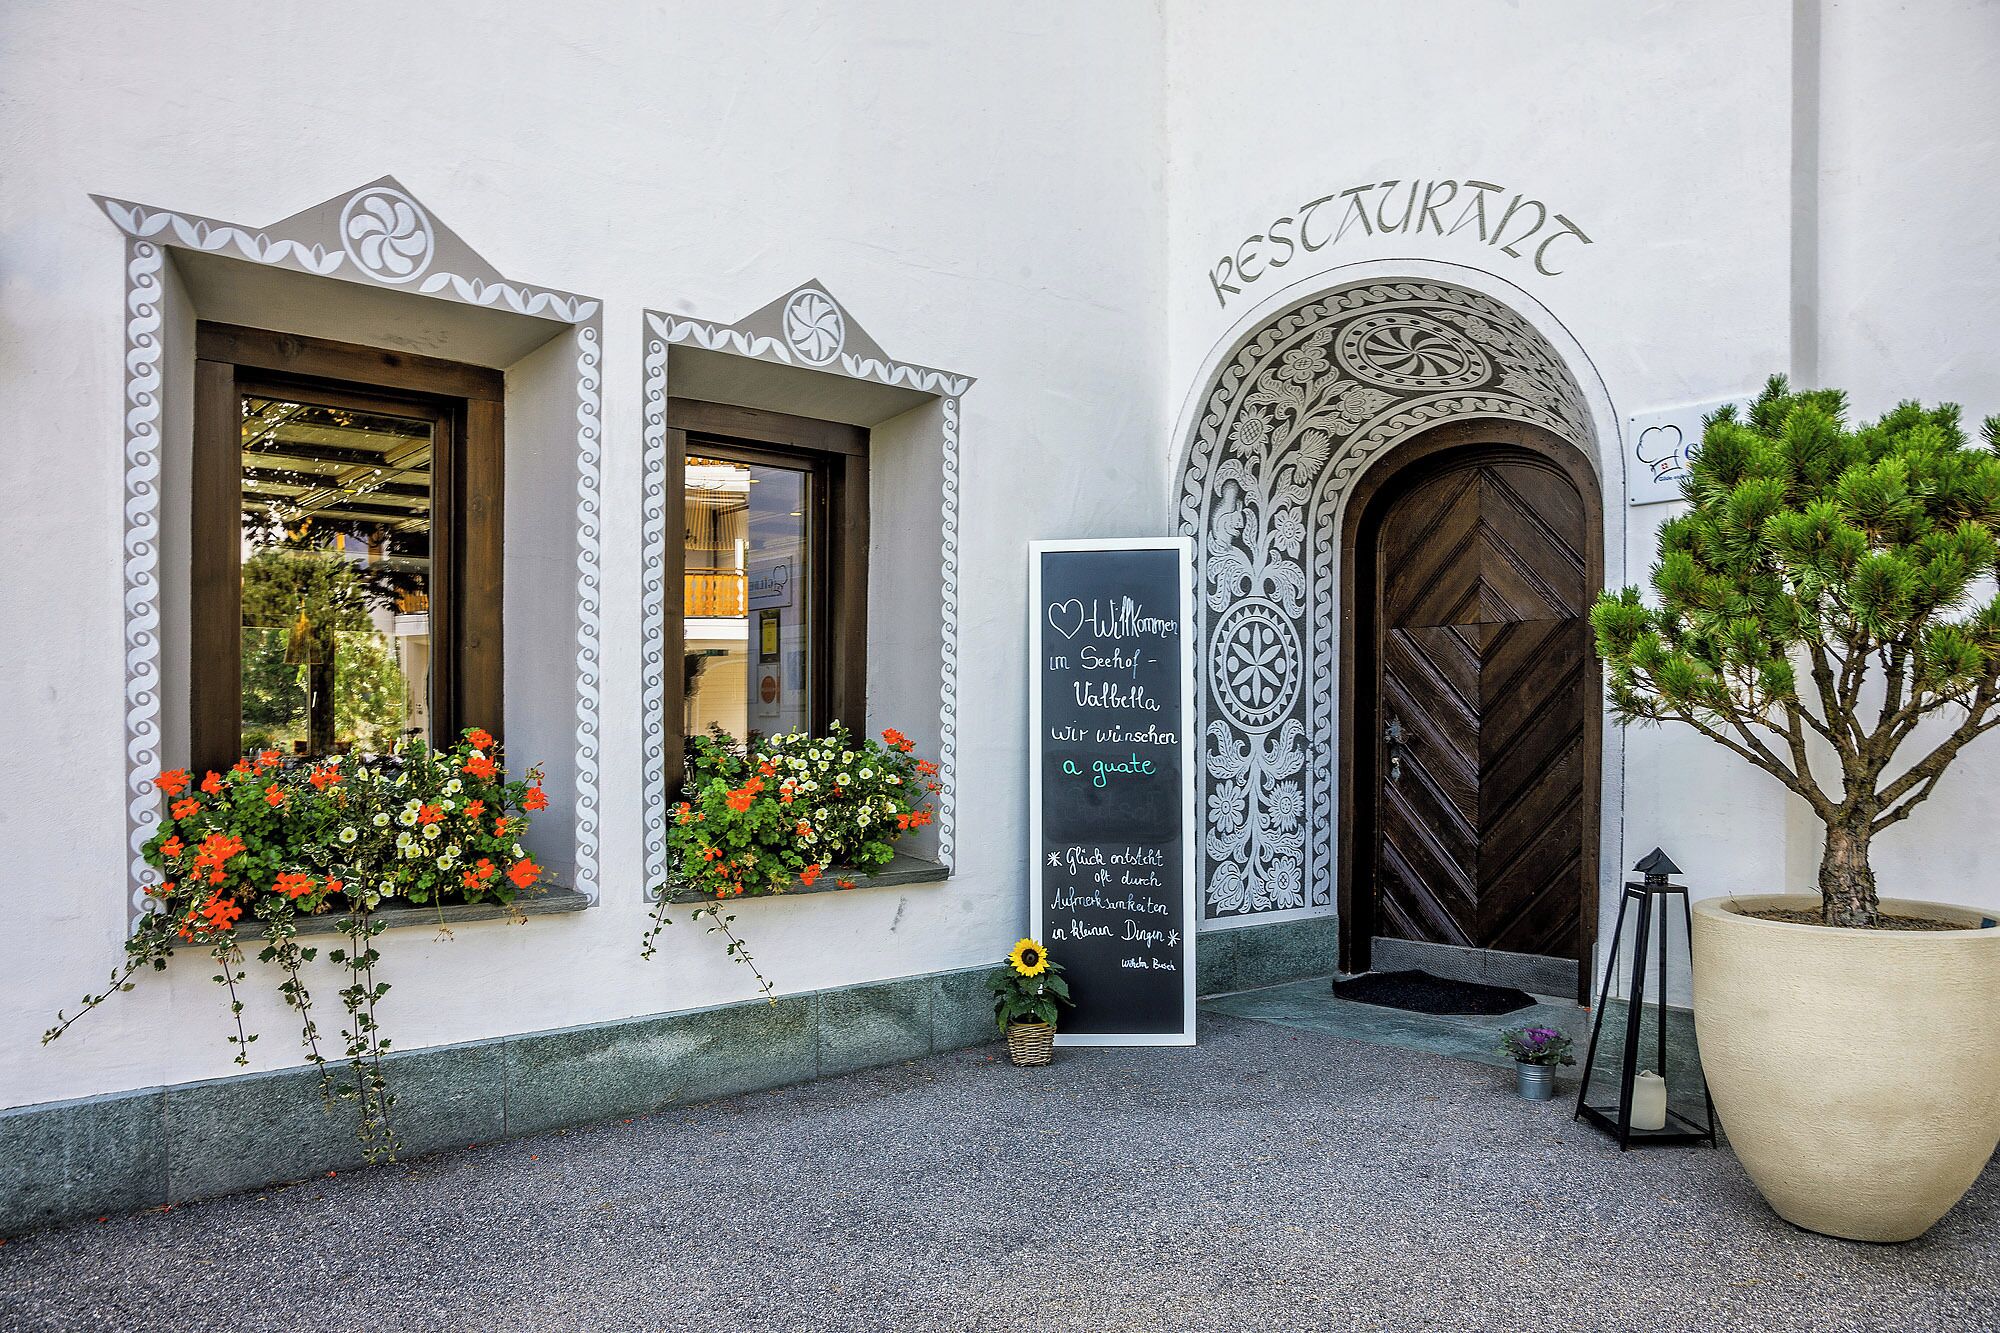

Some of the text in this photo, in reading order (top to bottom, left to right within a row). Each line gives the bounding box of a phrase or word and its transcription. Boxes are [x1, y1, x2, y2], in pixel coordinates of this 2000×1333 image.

[1208, 179, 1593, 309] RESTAURANT
[1081, 645, 1140, 679] Seehof
[1073, 681, 1161, 711] Valbella
[1096, 724, 1178, 744] wünschen
[1062, 753, 1156, 787] a guate
[1066, 846, 1163, 875] Glück entsteht
[1095, 869, 1162, 887] oft durch
[1051, 918, 1165, 948] in kleinen Dingen
